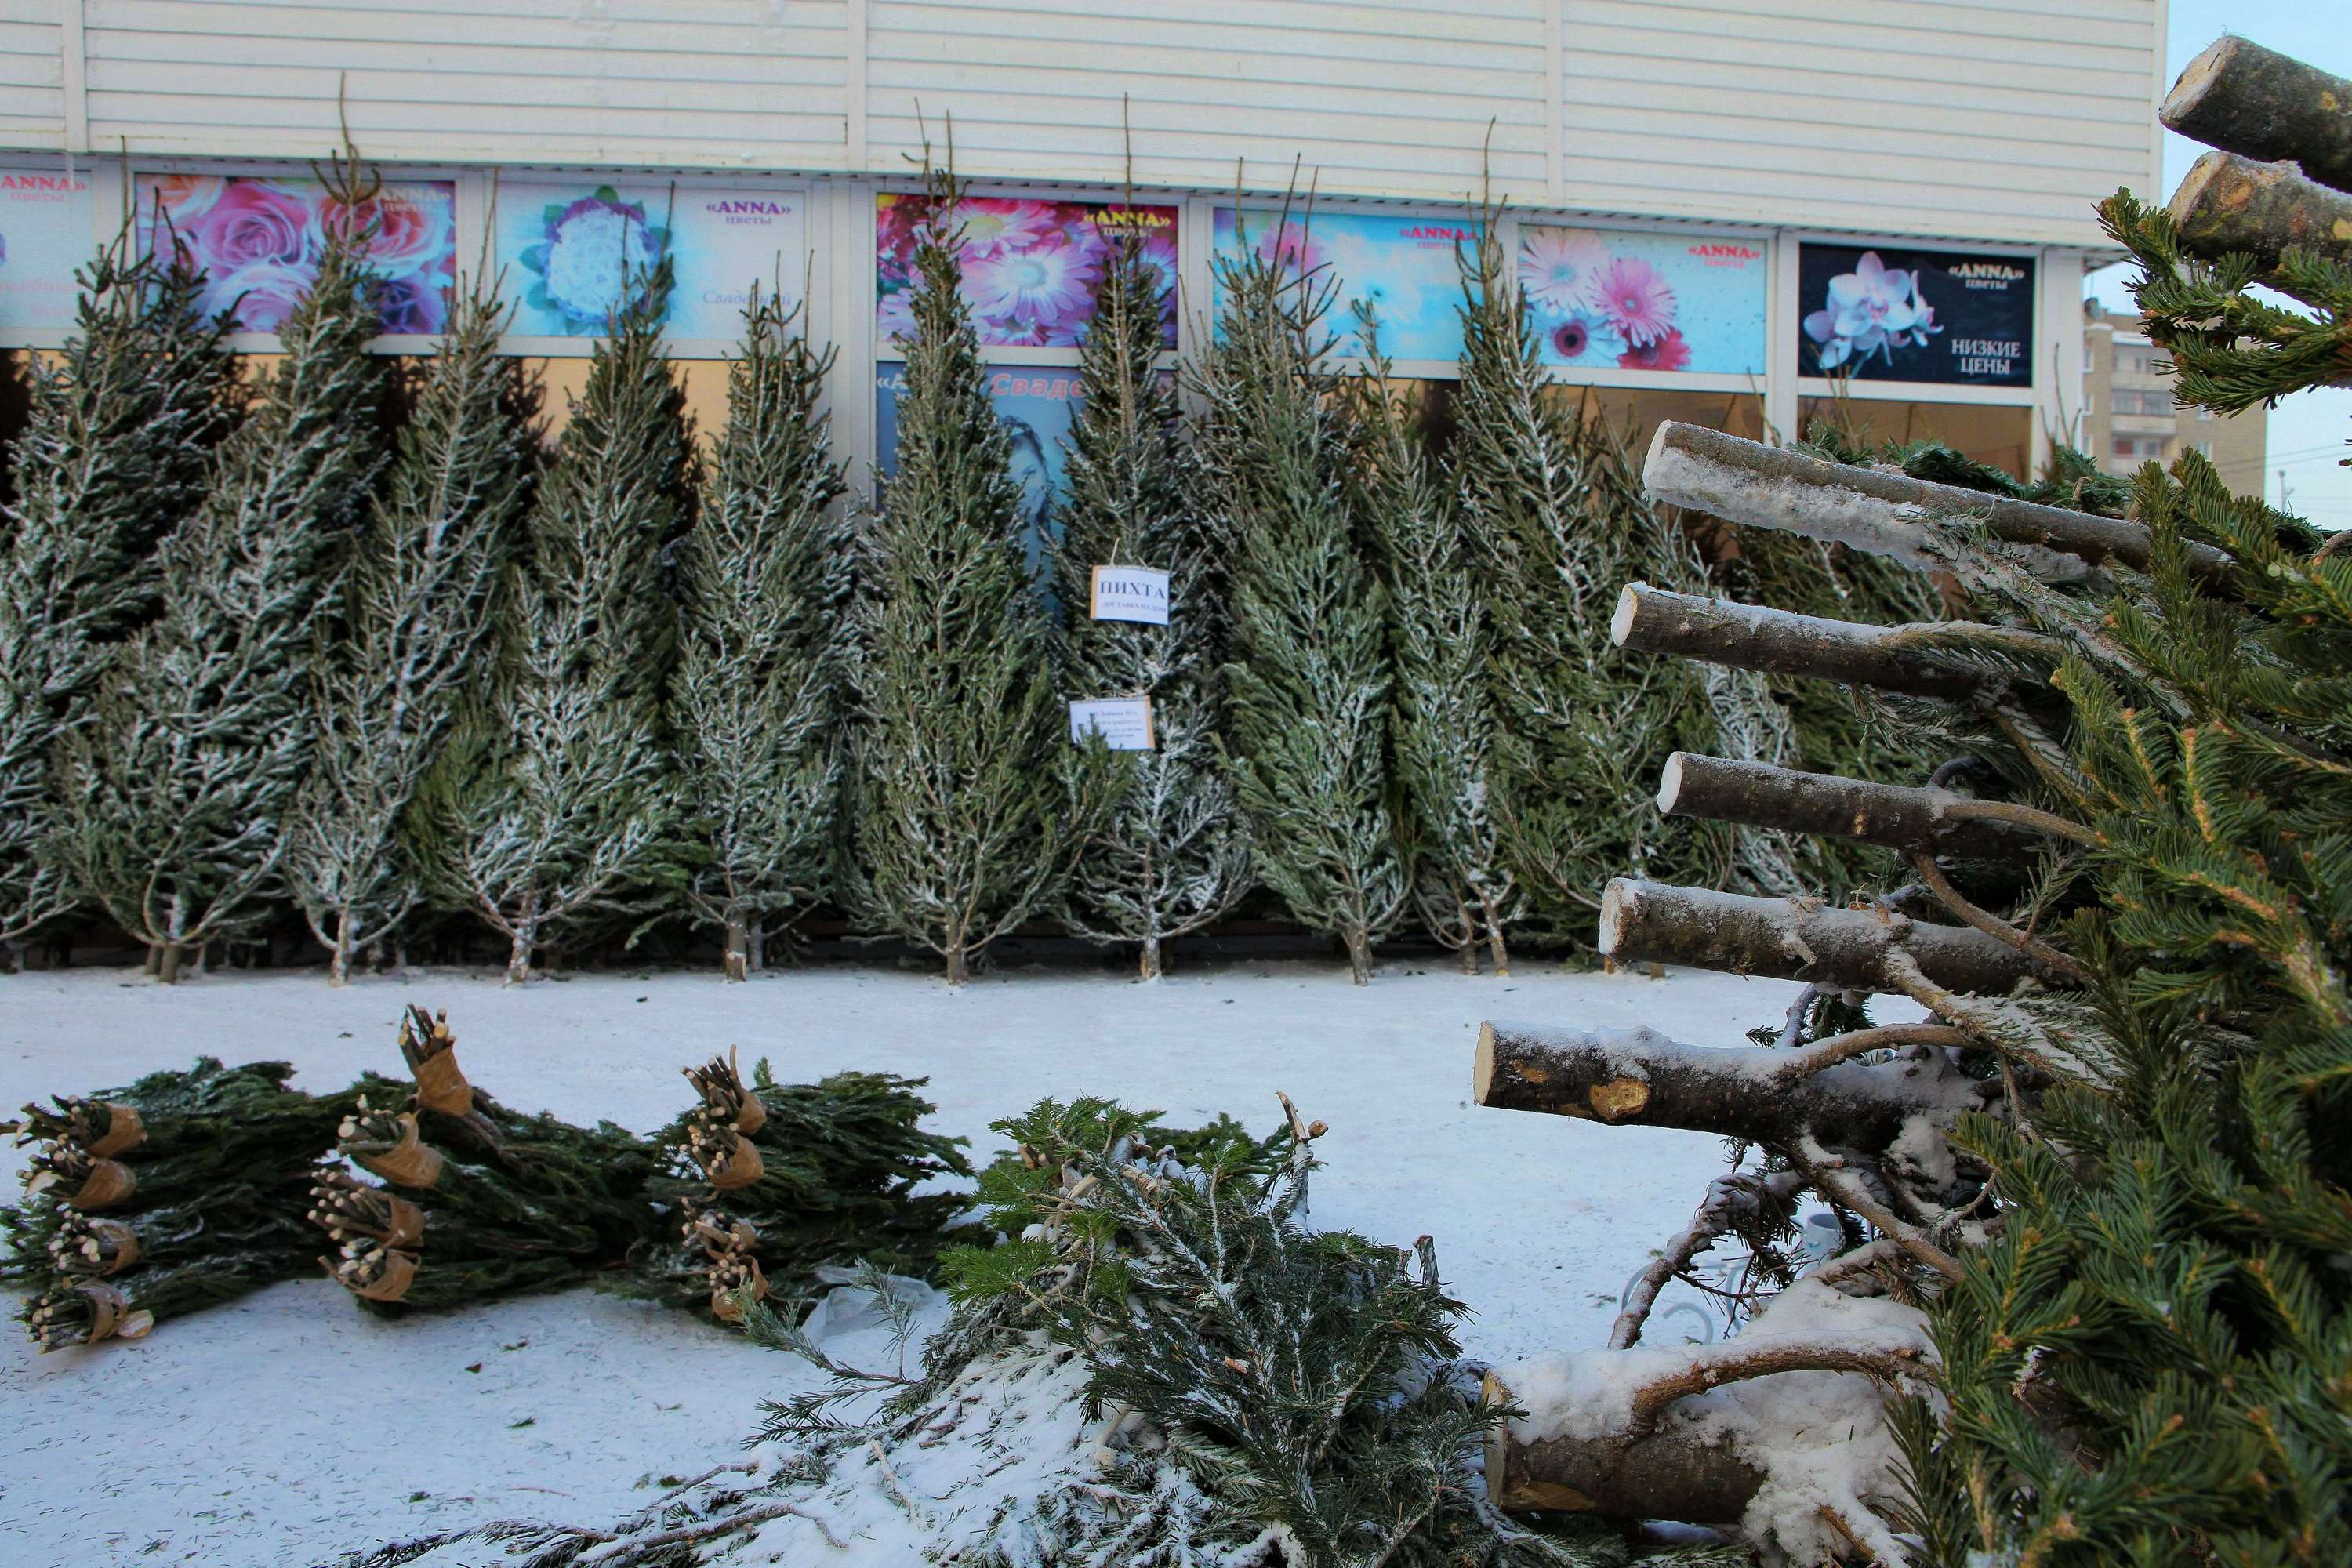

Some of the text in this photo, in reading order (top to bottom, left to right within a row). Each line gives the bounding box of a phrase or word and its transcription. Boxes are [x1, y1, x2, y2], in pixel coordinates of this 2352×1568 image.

[0, 175, 85, 191] ANNA»
[706, 201, 791, 214] «ANNA»
[1399, 225, 1477, 241] «ANNA»
[1688, 244, 1760, 260] «ANNA»
[1948, 263, 2025, 280] «ANNA»
[1965, 278, 2008, 291] цветы
[1951, 339, 2021, 358] НИЗКИЕ
[1961, 357, 2011, 376] ЦЕНЫ
[990, 372, 1090, 401] Сваде
[1100, 581, 1166, 601] ПИХТА
